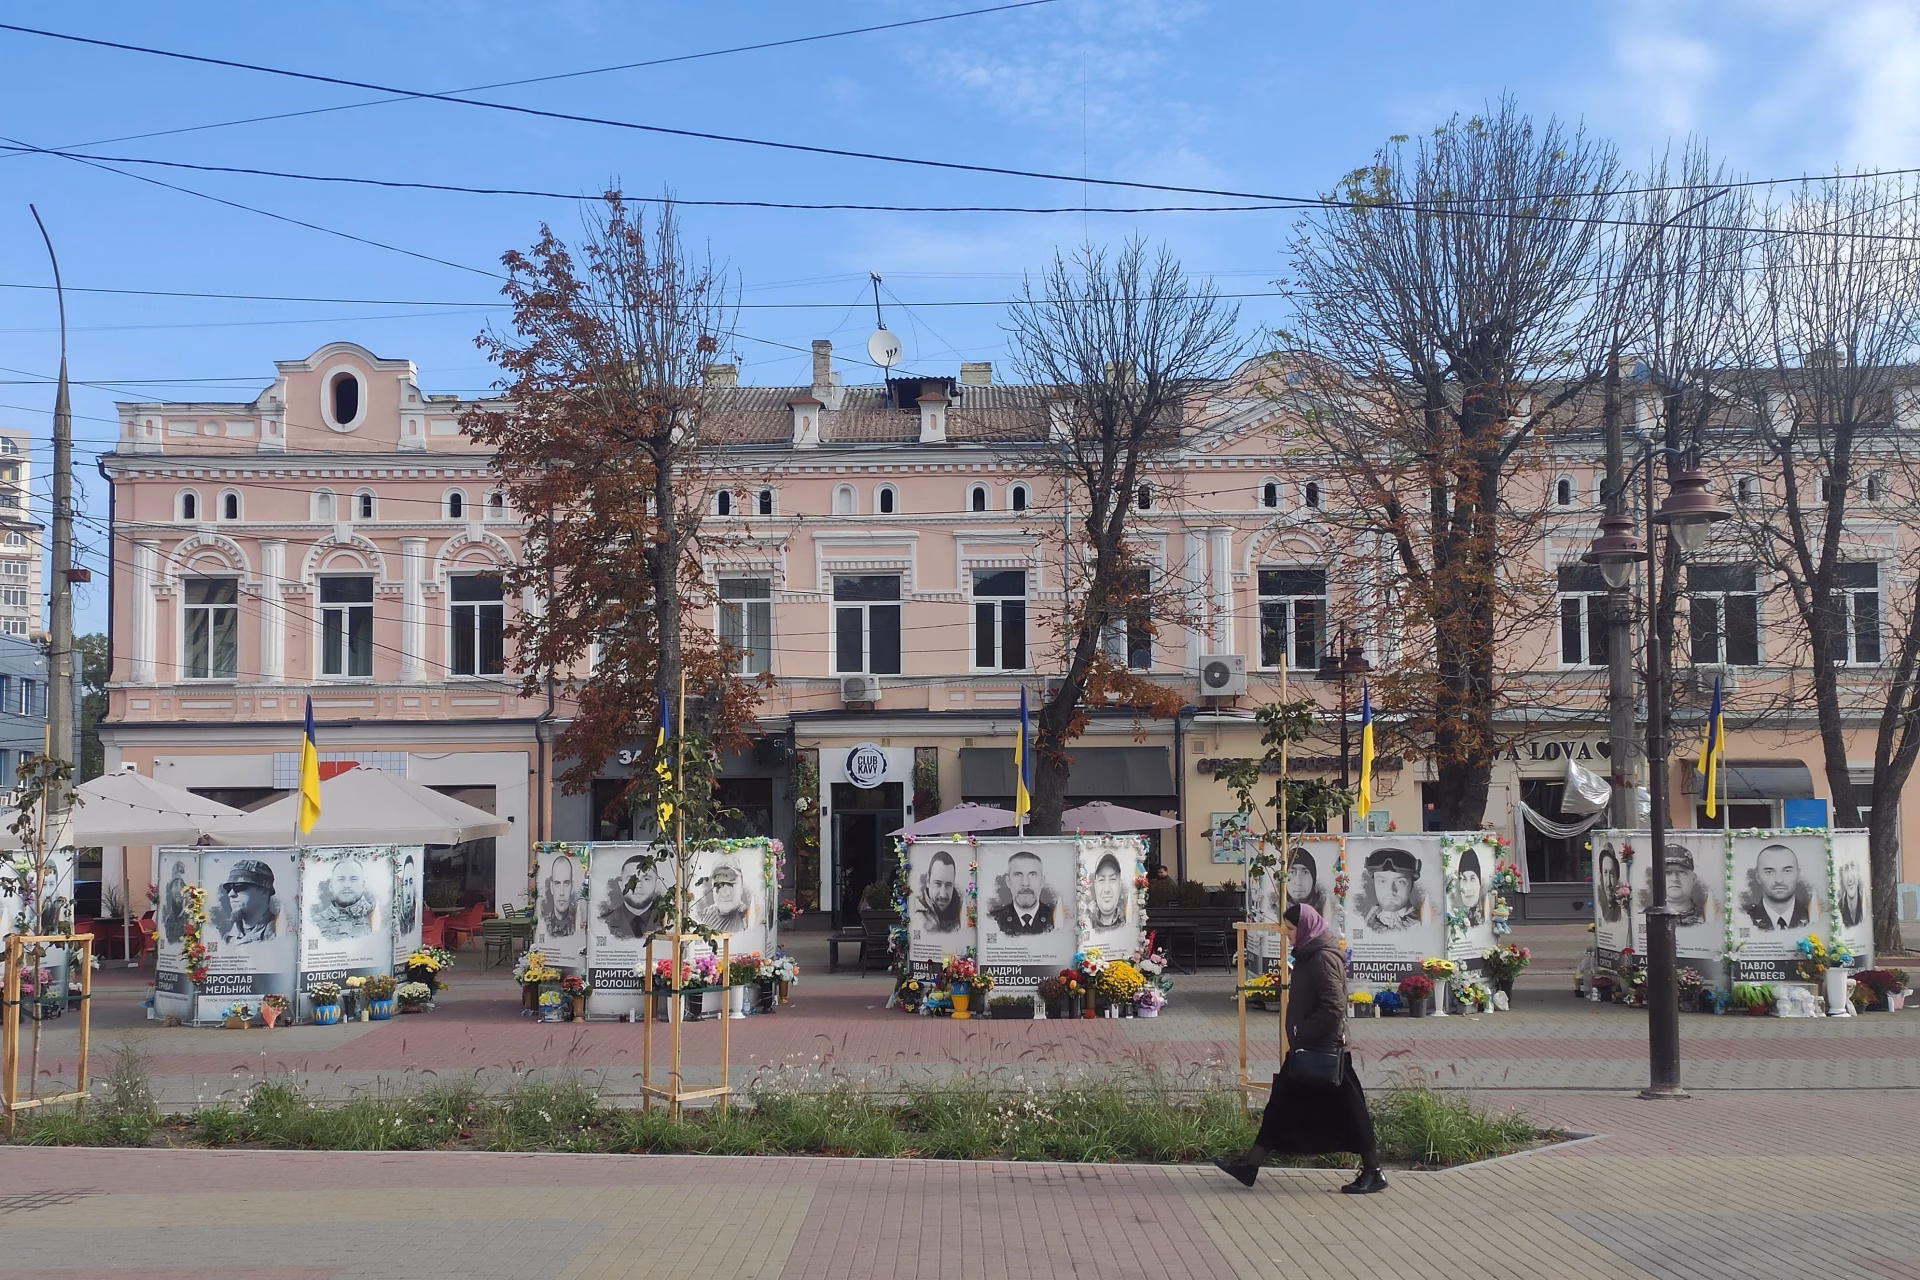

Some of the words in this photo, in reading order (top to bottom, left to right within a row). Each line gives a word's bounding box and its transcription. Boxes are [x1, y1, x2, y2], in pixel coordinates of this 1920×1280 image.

[1530, 742, 1593, 760] LOVA
[857, 755, 878, 765] CLUB
[857, 764, 878, 774] KAVY
[913, 962, 929, 971] ІВАН
[987, 964, 1022, 975] АНДРІЙ
[1353, 962, 1413, 972] ВЛАДИСЛАВ
[1740, 961, 1776, 970] ПАВЛО
[306, 969, 347, 981] ОЛЕКСІЙ
[595, 969, 636, 979] ДМИТРО
[1353, 972, 1397, 981] КРУЧІНІН
[1740, 971, 1786, 980] МАТВЕЄВ
[205, 975, 253, 984] ЯРОСЛАВ
[205, 985, 252, 994] МЕЛЬНИК
